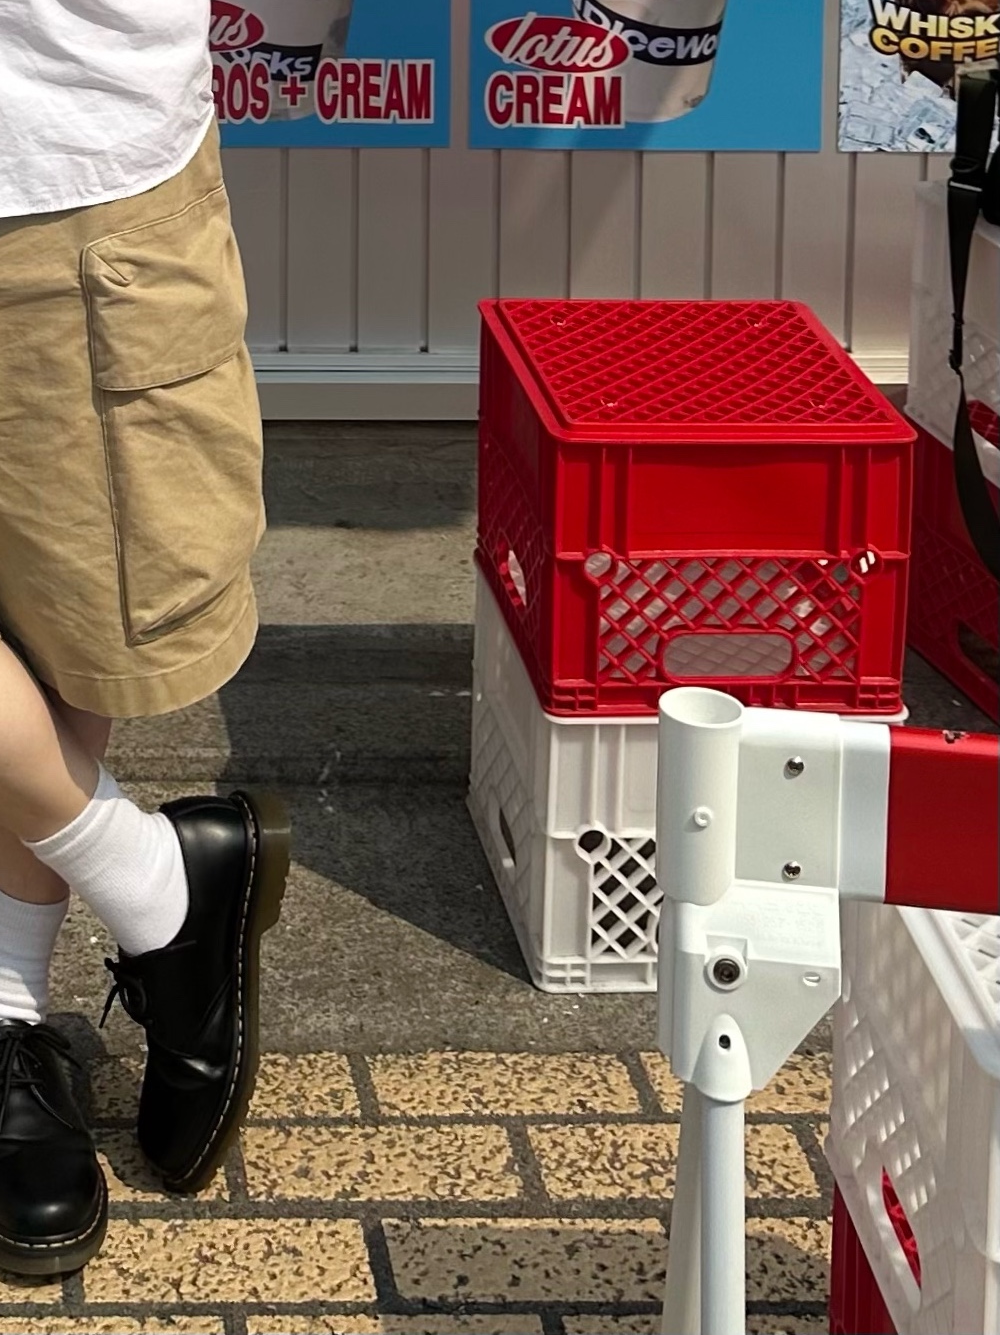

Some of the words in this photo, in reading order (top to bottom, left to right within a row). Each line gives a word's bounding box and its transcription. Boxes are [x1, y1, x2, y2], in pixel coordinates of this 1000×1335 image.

[281, 75, 306, 107] +
[316, 61, 432, 121] CREAM
[487, 73, 623, 126] CREAM
